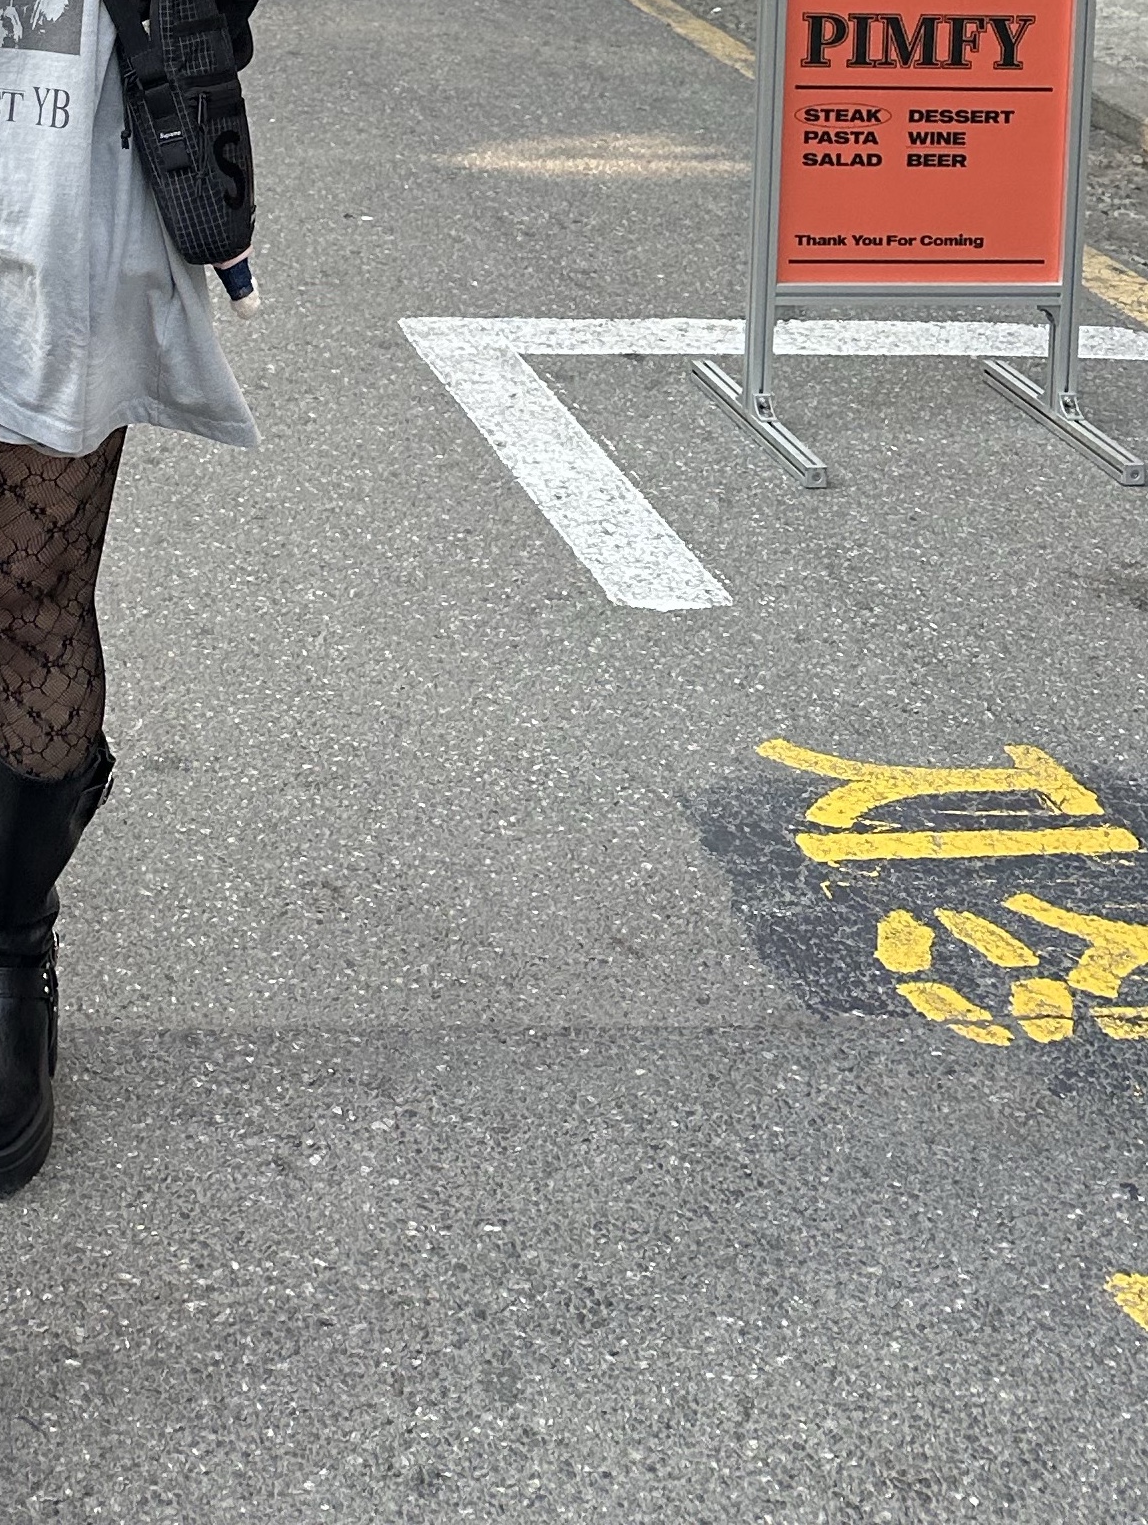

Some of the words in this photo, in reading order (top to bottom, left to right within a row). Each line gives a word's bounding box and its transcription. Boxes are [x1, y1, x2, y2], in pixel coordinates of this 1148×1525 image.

[800, 12, 1036, 70] PIMFY
[32, 86, 71, 129] YB
[803, 108, 882, 123] STEAK
[908, 109, 1015, 124] DESSERT
[803, 131, 879, 145] PASTA
[908, 131, 967, 146] WINE
[802, 153, 883, 168] SALAD
[907, 154, 967, 168] BEER
[213, 129, 246, 211] S
[795, 234, 847, 247] Thank
[852, 234, 884, 247] You
[886, 234, 917, 247] For
[920, 233, 985, 249] Coming
